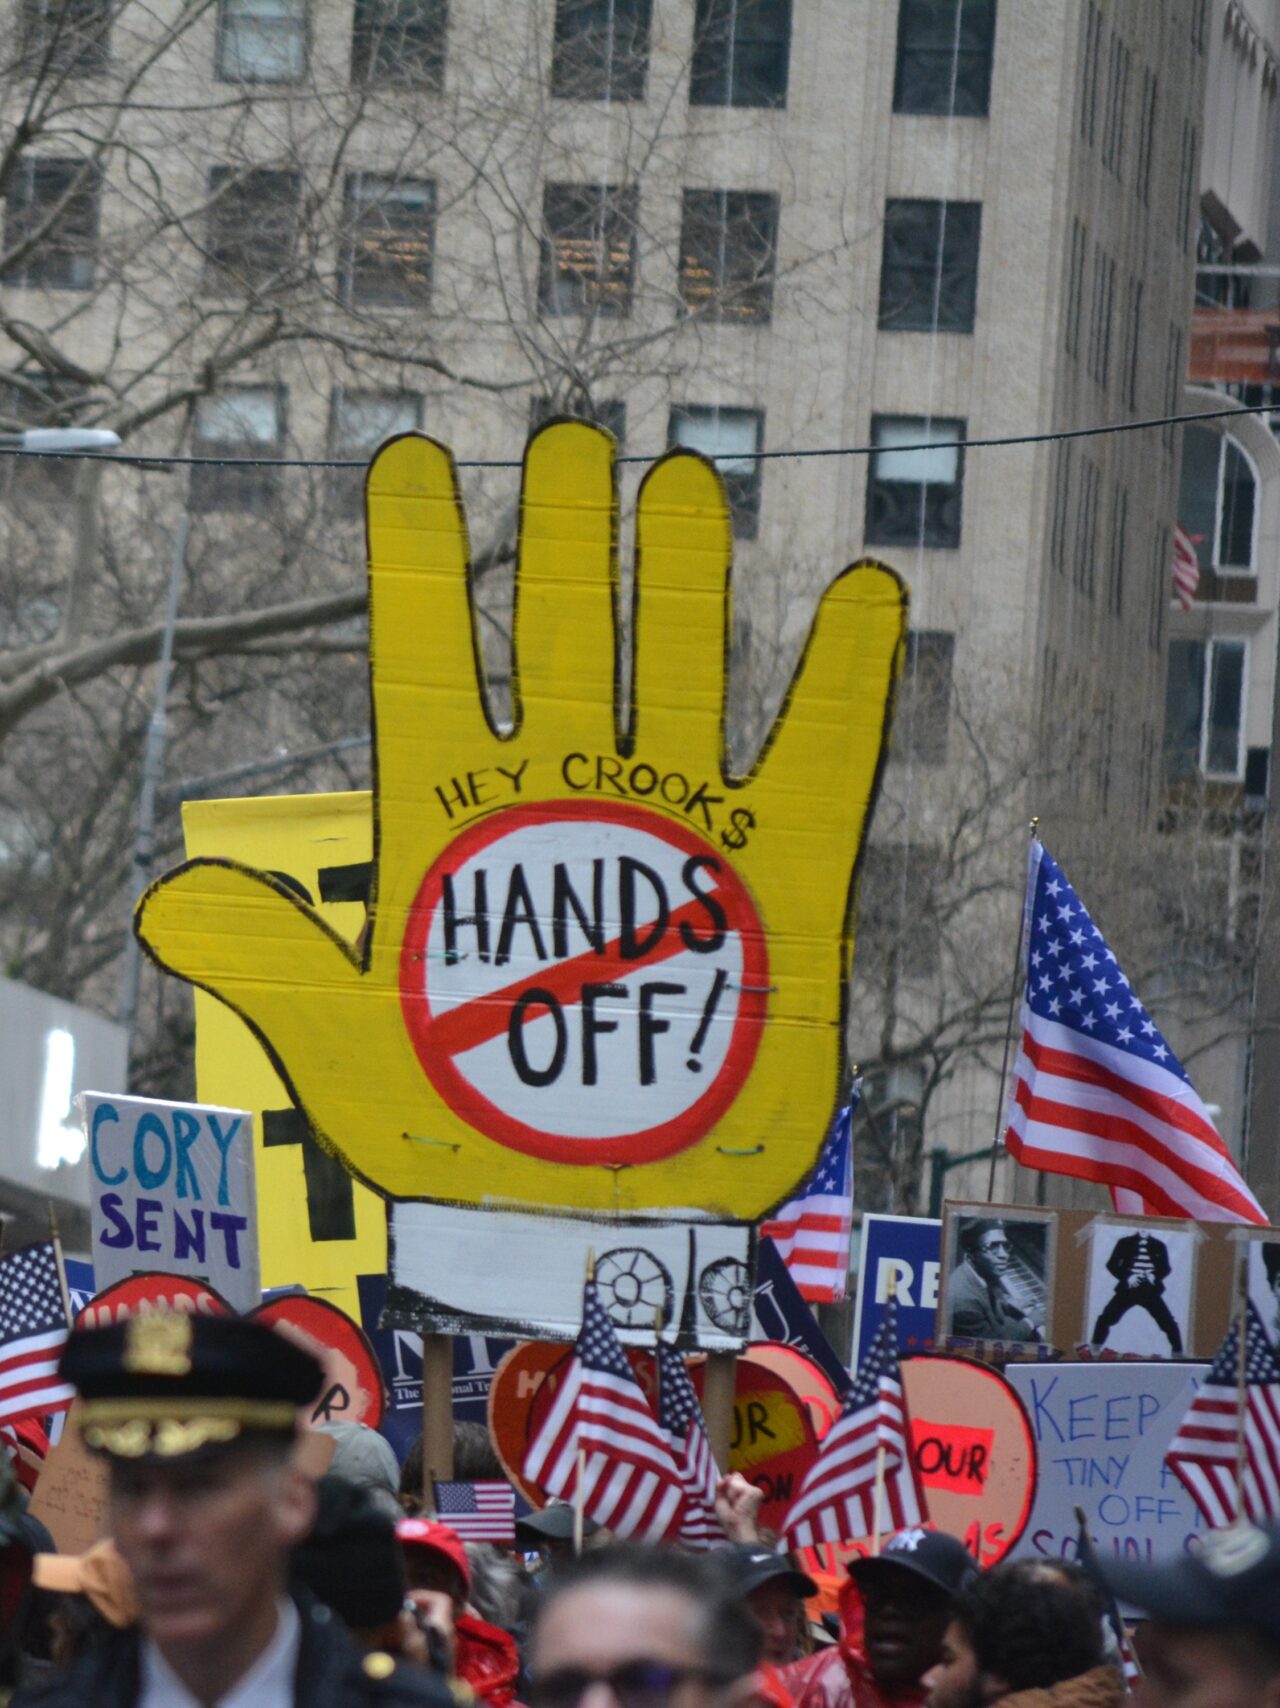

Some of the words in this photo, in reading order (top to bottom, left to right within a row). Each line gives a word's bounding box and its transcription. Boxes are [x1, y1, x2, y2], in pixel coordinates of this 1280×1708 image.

[434, 759, 530, 819] HEY
[441, 855, 728, 967] HANDS
[506, 968, 729, 1087] OFF!
[91, 1102, 242, 1206] CORY
[99, 1193, 248, 1270] SENT
[394, 1387, 420, 1400] The
[1030, 1376, 1161, 1443] KEEP
[916, 1437, 987, 1484] OUR
[1051, 1455, 1131, 1489] TINY
[1098, 1494, 1182, 1527] OFF
